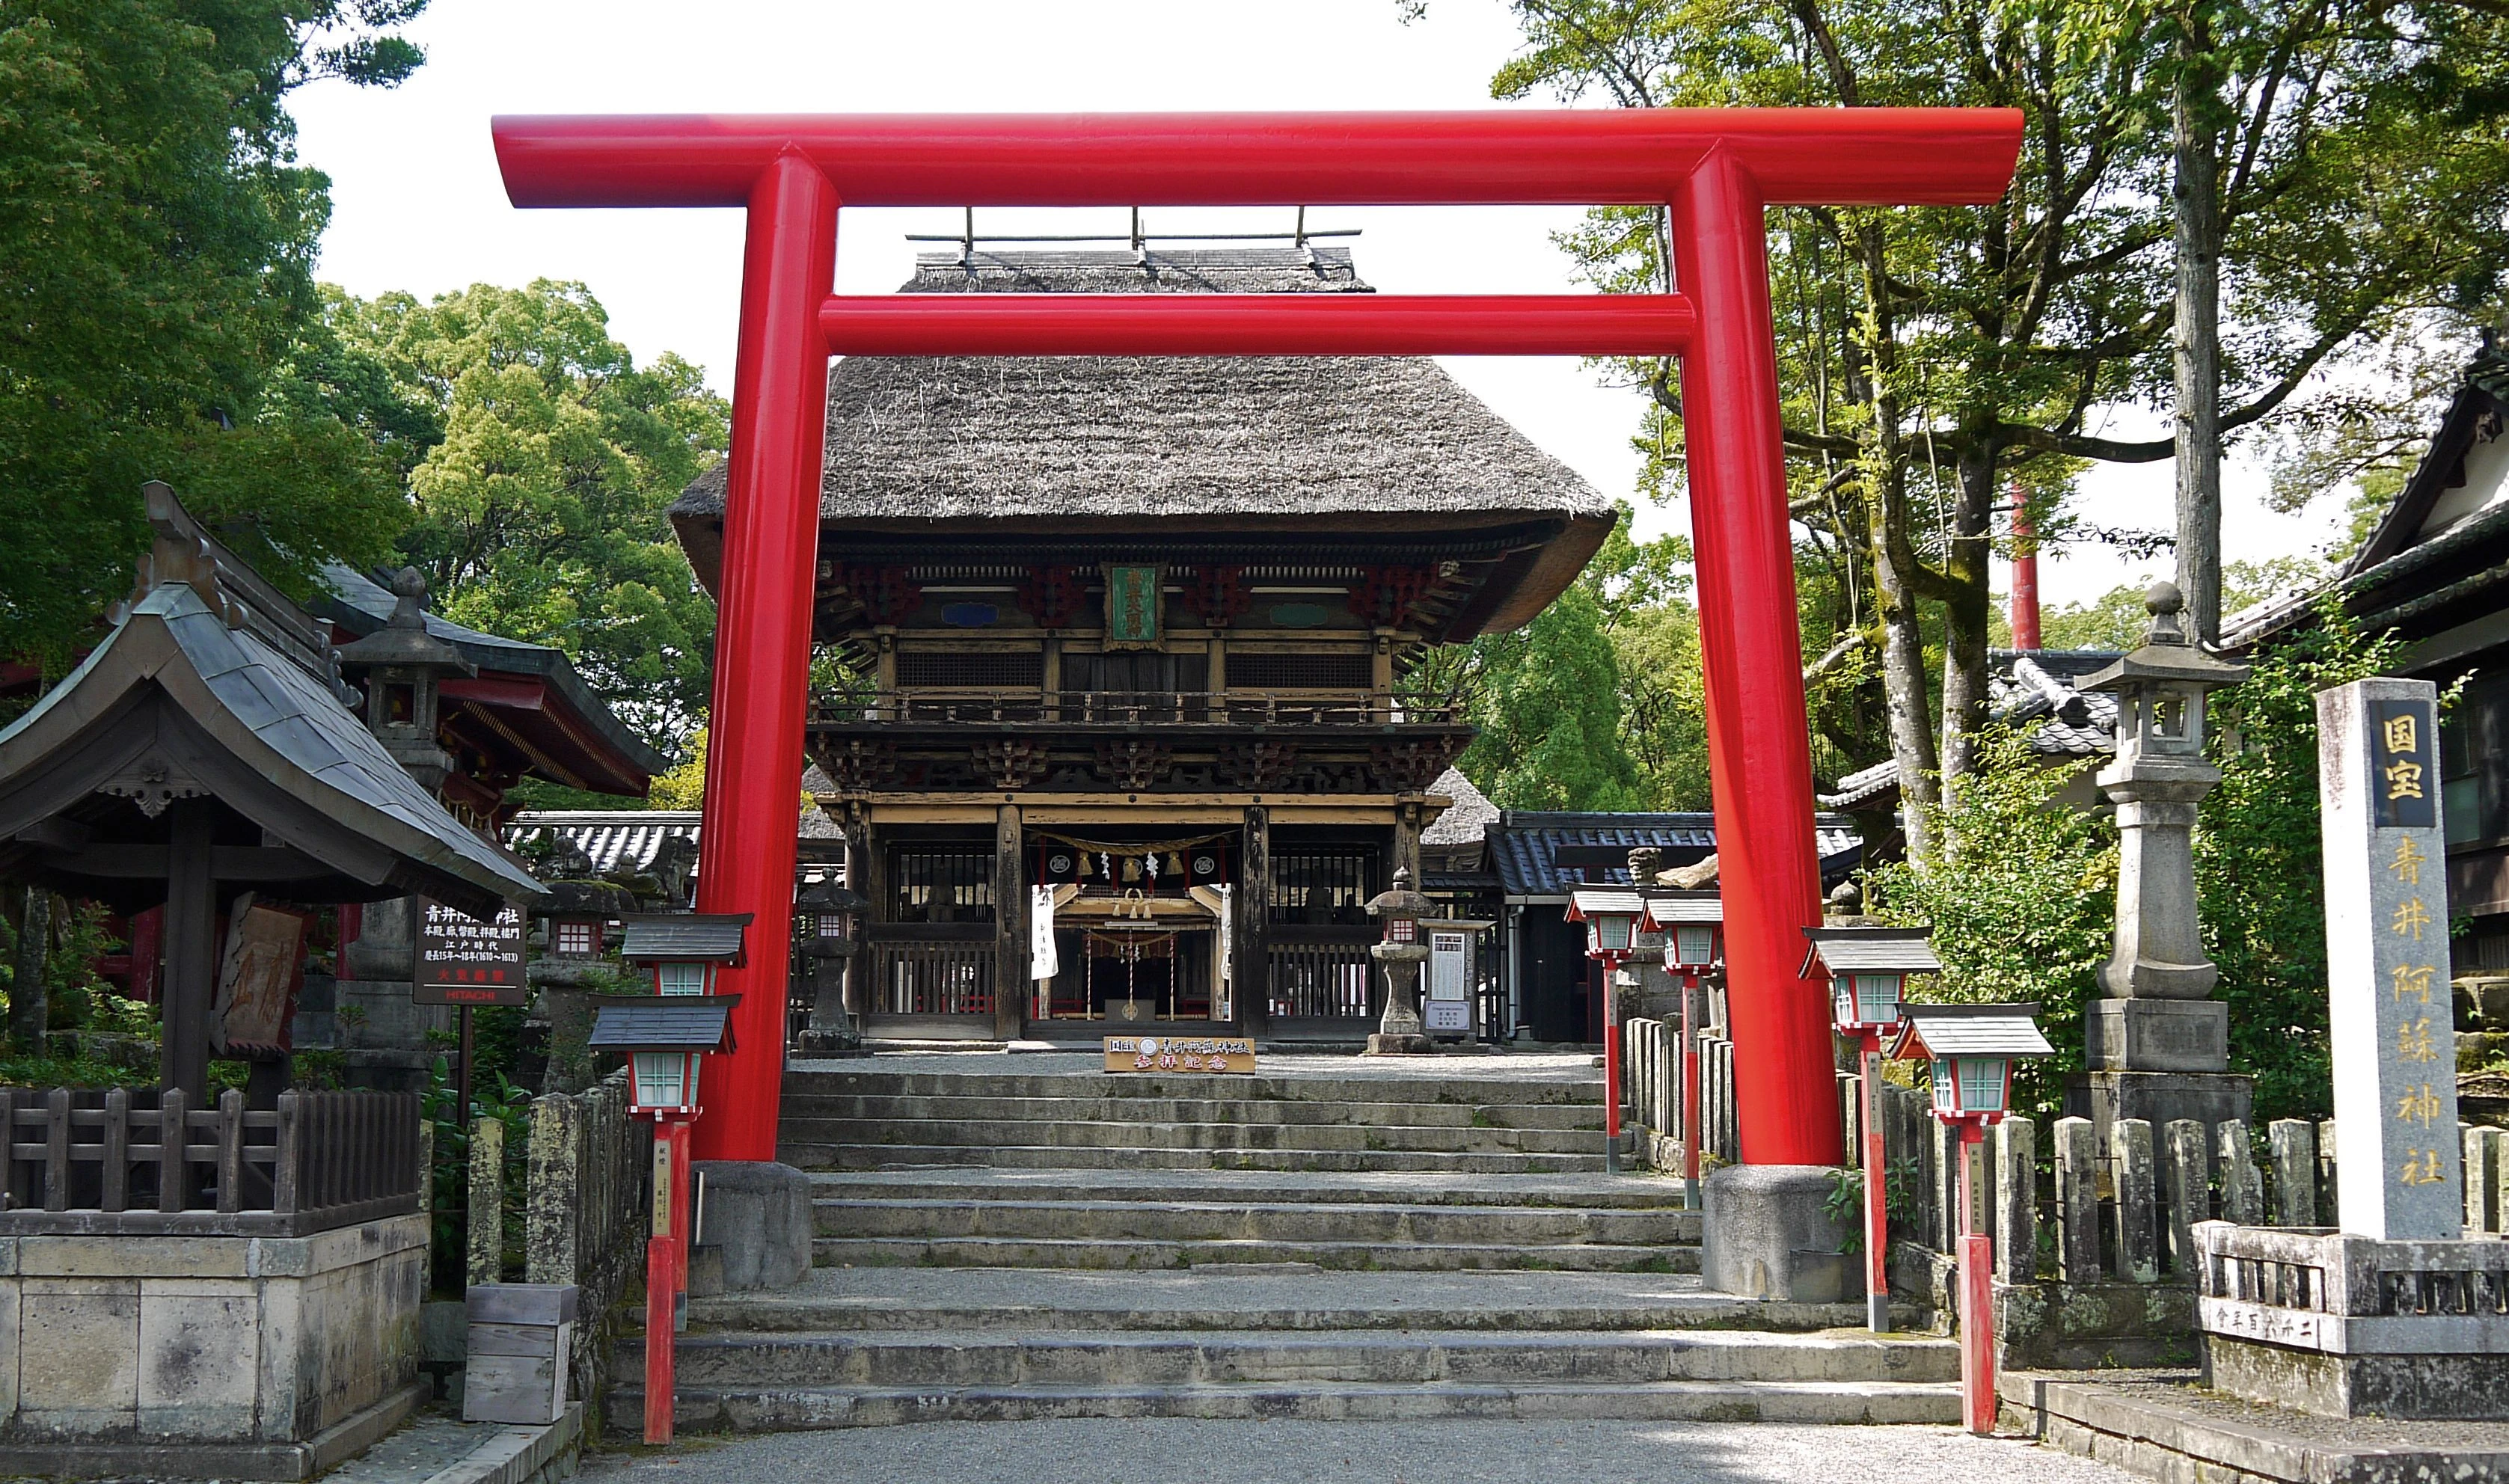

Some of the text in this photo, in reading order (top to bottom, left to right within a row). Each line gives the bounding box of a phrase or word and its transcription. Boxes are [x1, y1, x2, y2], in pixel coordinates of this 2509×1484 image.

[2383, 714, 2424, 800] 国宝
[425, 904, 520, 925] 青井阿社
[446, 990, 496, 1001] HITACHI
[2389, 835, 2446, 1187] 青井阿蘇神社
[1160, 1038, 1251, 1055] 青井阿蘇神社
[1133, 1055, 1228, 1070] 参拝記念
